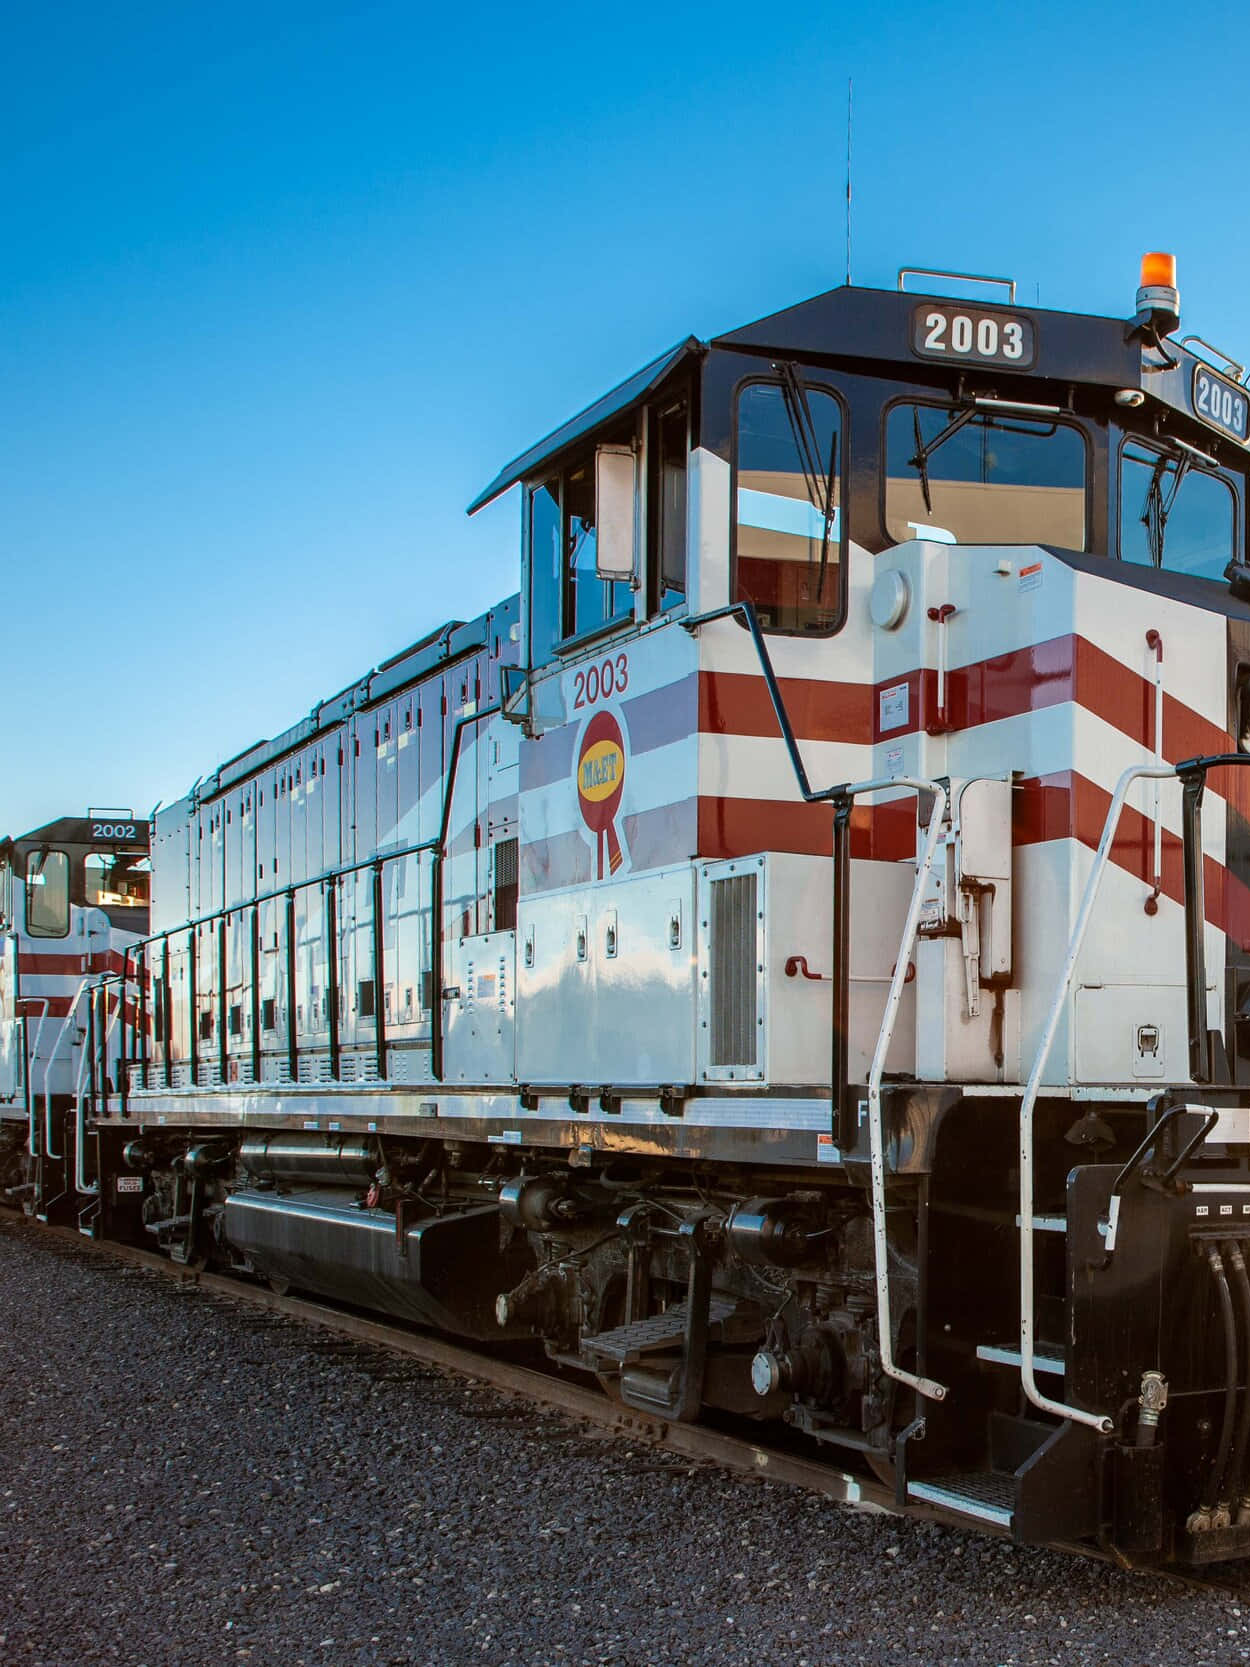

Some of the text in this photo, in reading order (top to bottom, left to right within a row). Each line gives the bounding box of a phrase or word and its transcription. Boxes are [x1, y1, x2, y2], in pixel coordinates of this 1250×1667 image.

[924, 312, 1023, 359] 2003
[1198, 376, 1243, 433] 2003
[573, 653, 628, 710] 2003
[582, 751, 618, 790] M&ET
[92, 824, 136, 839] 2002
[858, 1100, 868, 1128] F
